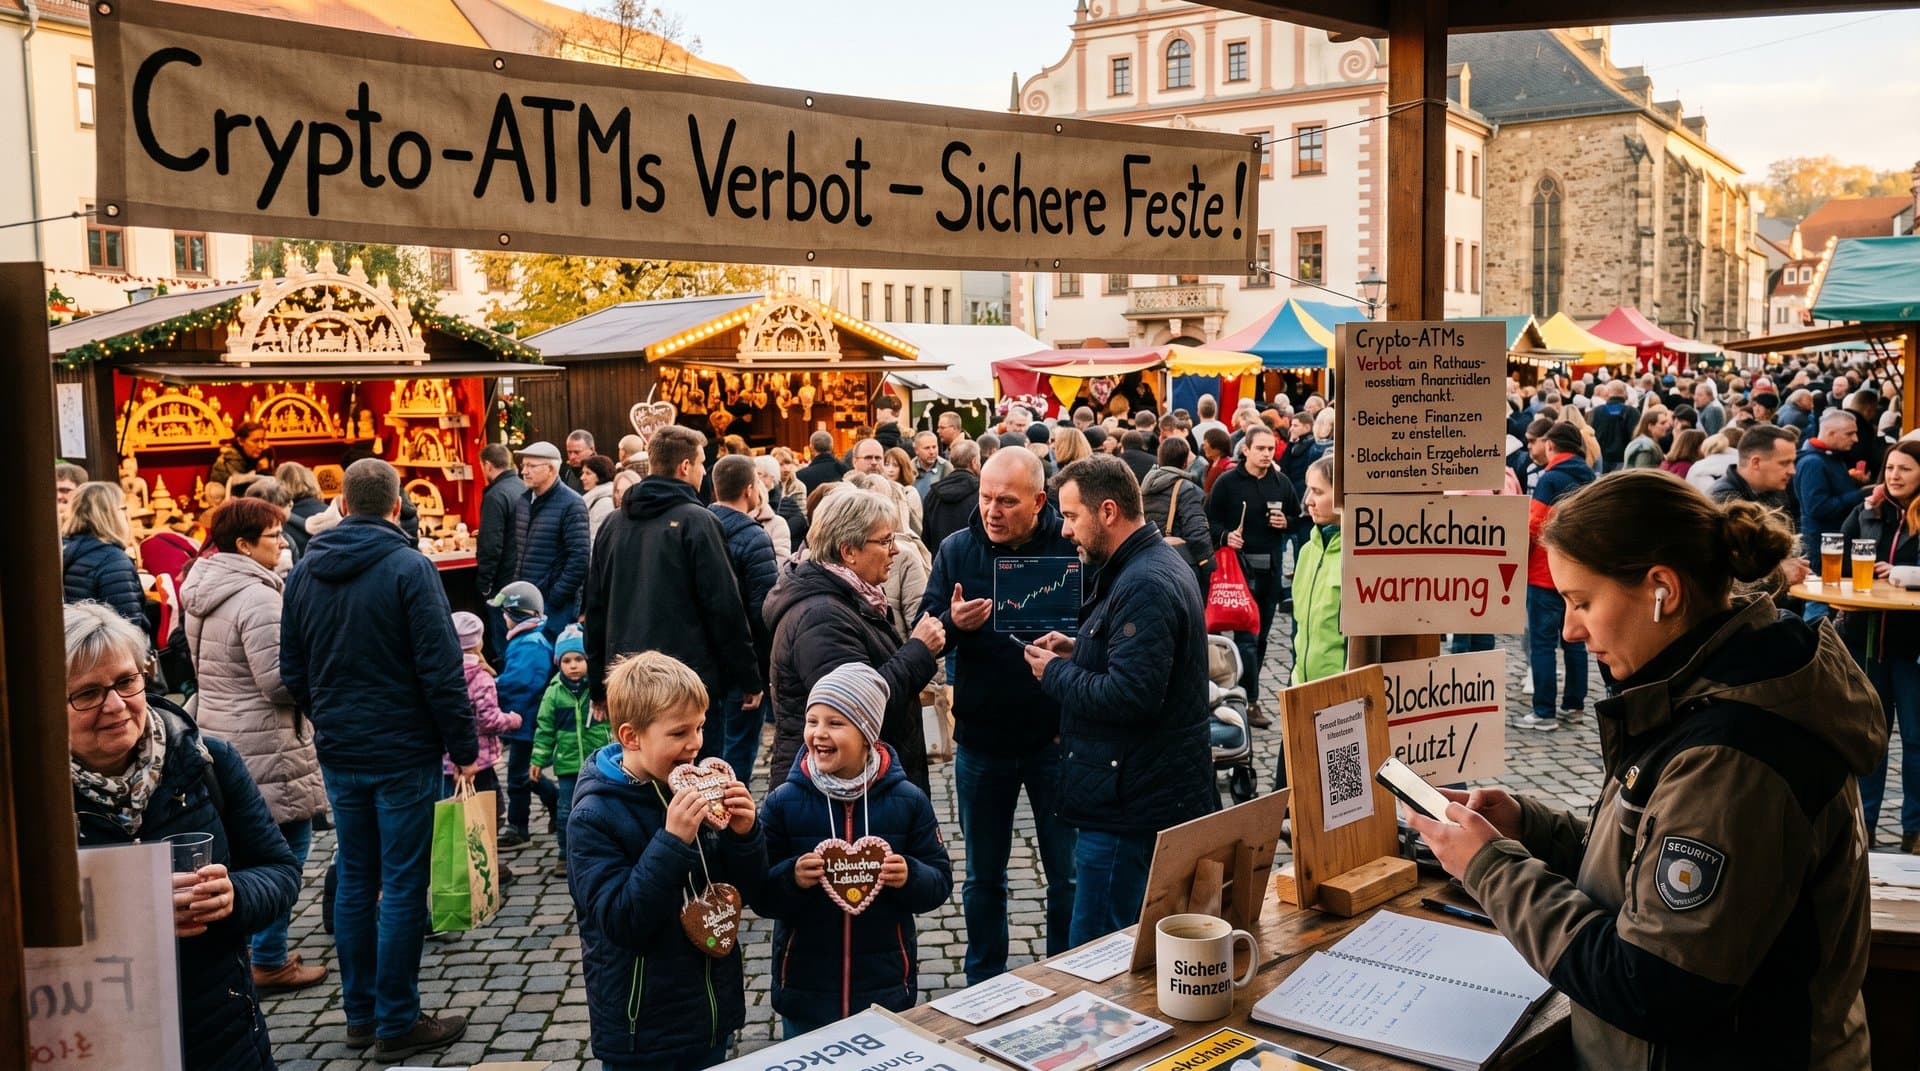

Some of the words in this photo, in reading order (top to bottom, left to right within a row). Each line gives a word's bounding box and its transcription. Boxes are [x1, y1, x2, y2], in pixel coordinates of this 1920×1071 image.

[132, 47, 665, 216] Crypto-ATMs
[688, 114, 872, 227] Verbot
[936, 141, 1106, 235] Sichere
[1123, 154, 1247, 240] Feste!
[1356, 328, 1465, 354] Crypto-ATMs
[1357, 355, 1402, 371] Verbot
[1433, 355, 1486, 369] Rathaus-
[1358, 411, 1418, 426] Beichene
[1425, 409, 1482, 423] Finanzen
[1357, 447, 1422, 463] Blockchain
[1355, 507, 1506, 547] Blockchain
[1667, 842, 1718, 864] SECURITY
[1174, 960, 1227, 977] Sichere
[1170, 978, 1231, 996] Finanzen
